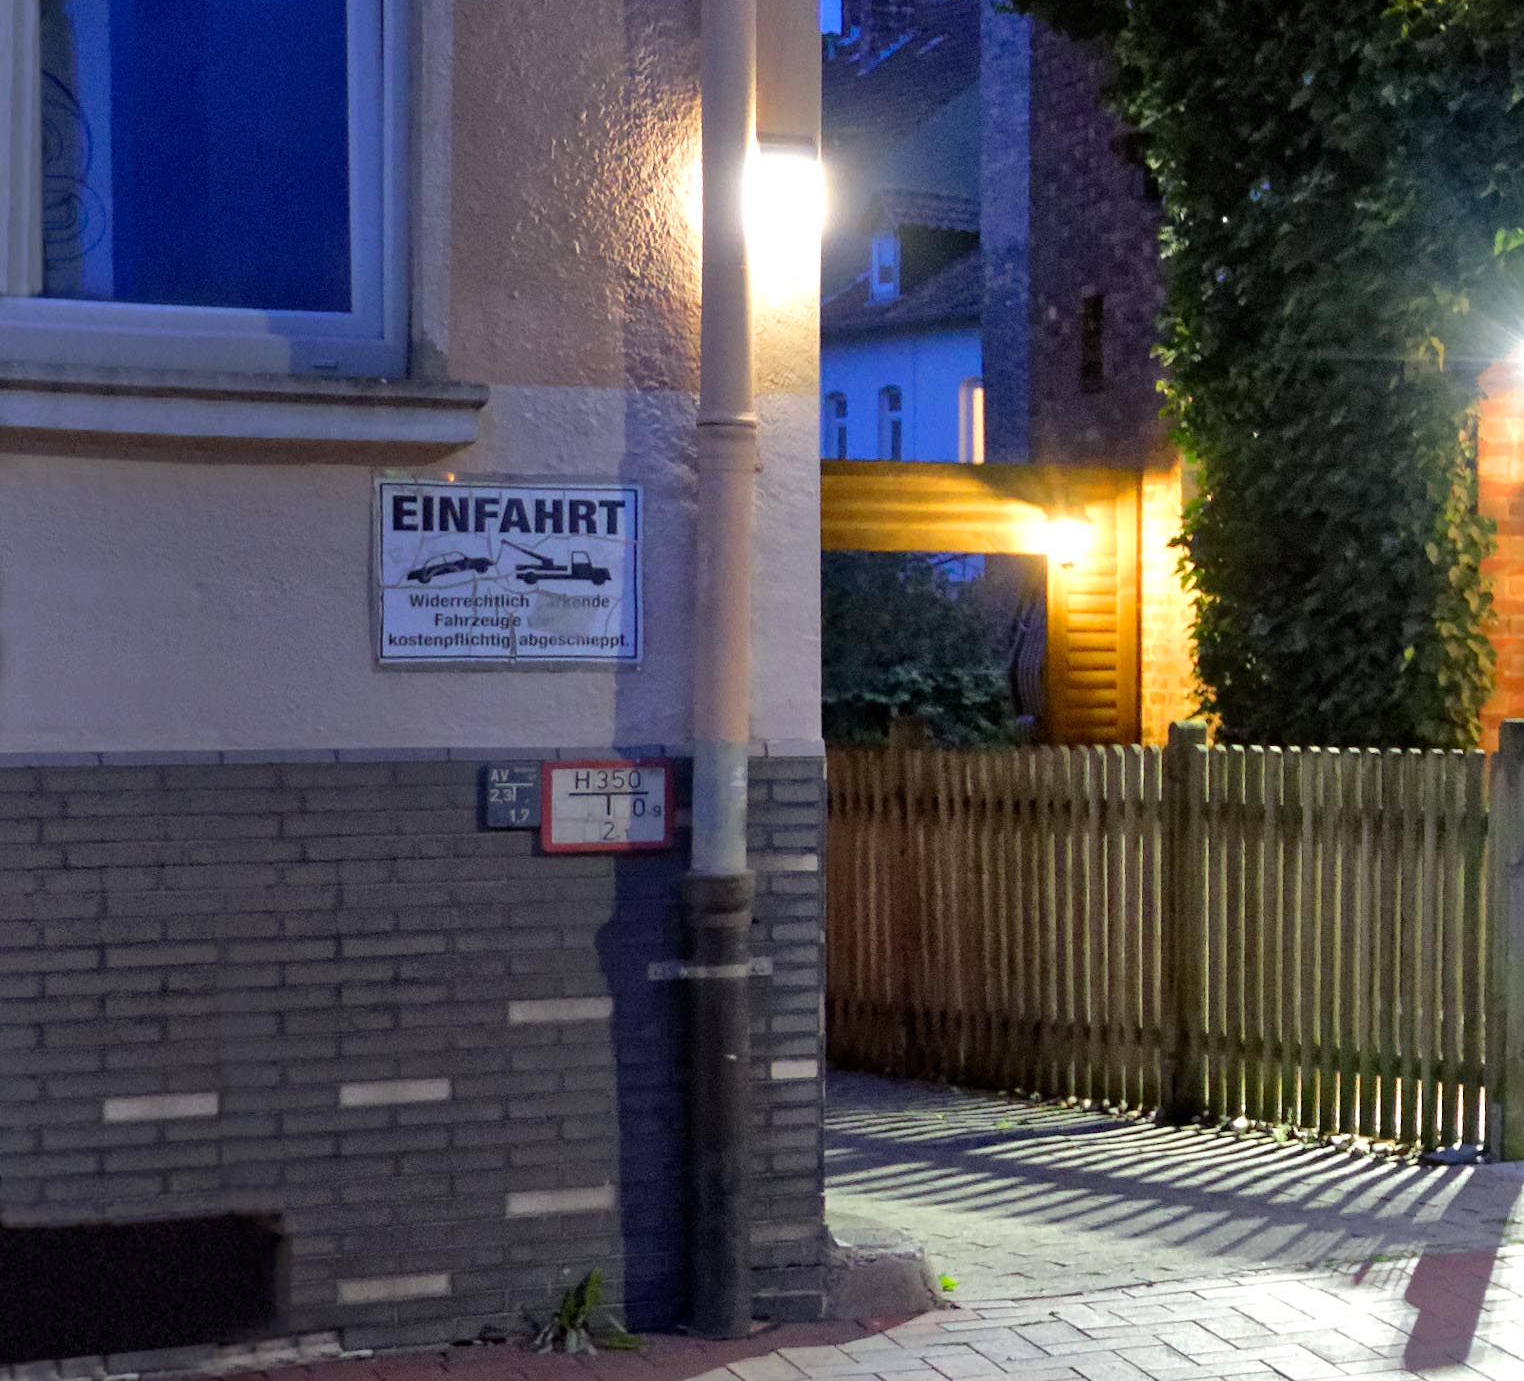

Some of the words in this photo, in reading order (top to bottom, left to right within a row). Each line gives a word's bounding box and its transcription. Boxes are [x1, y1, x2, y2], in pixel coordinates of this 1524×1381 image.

[391, 494, 627, 536] EINFAHRT
[409, 593, 530, 609] Widerrechtlich
[434, 613, 522, 630] Fahrzeuge
[388, 633, 511, 649] kostenpflichtig
